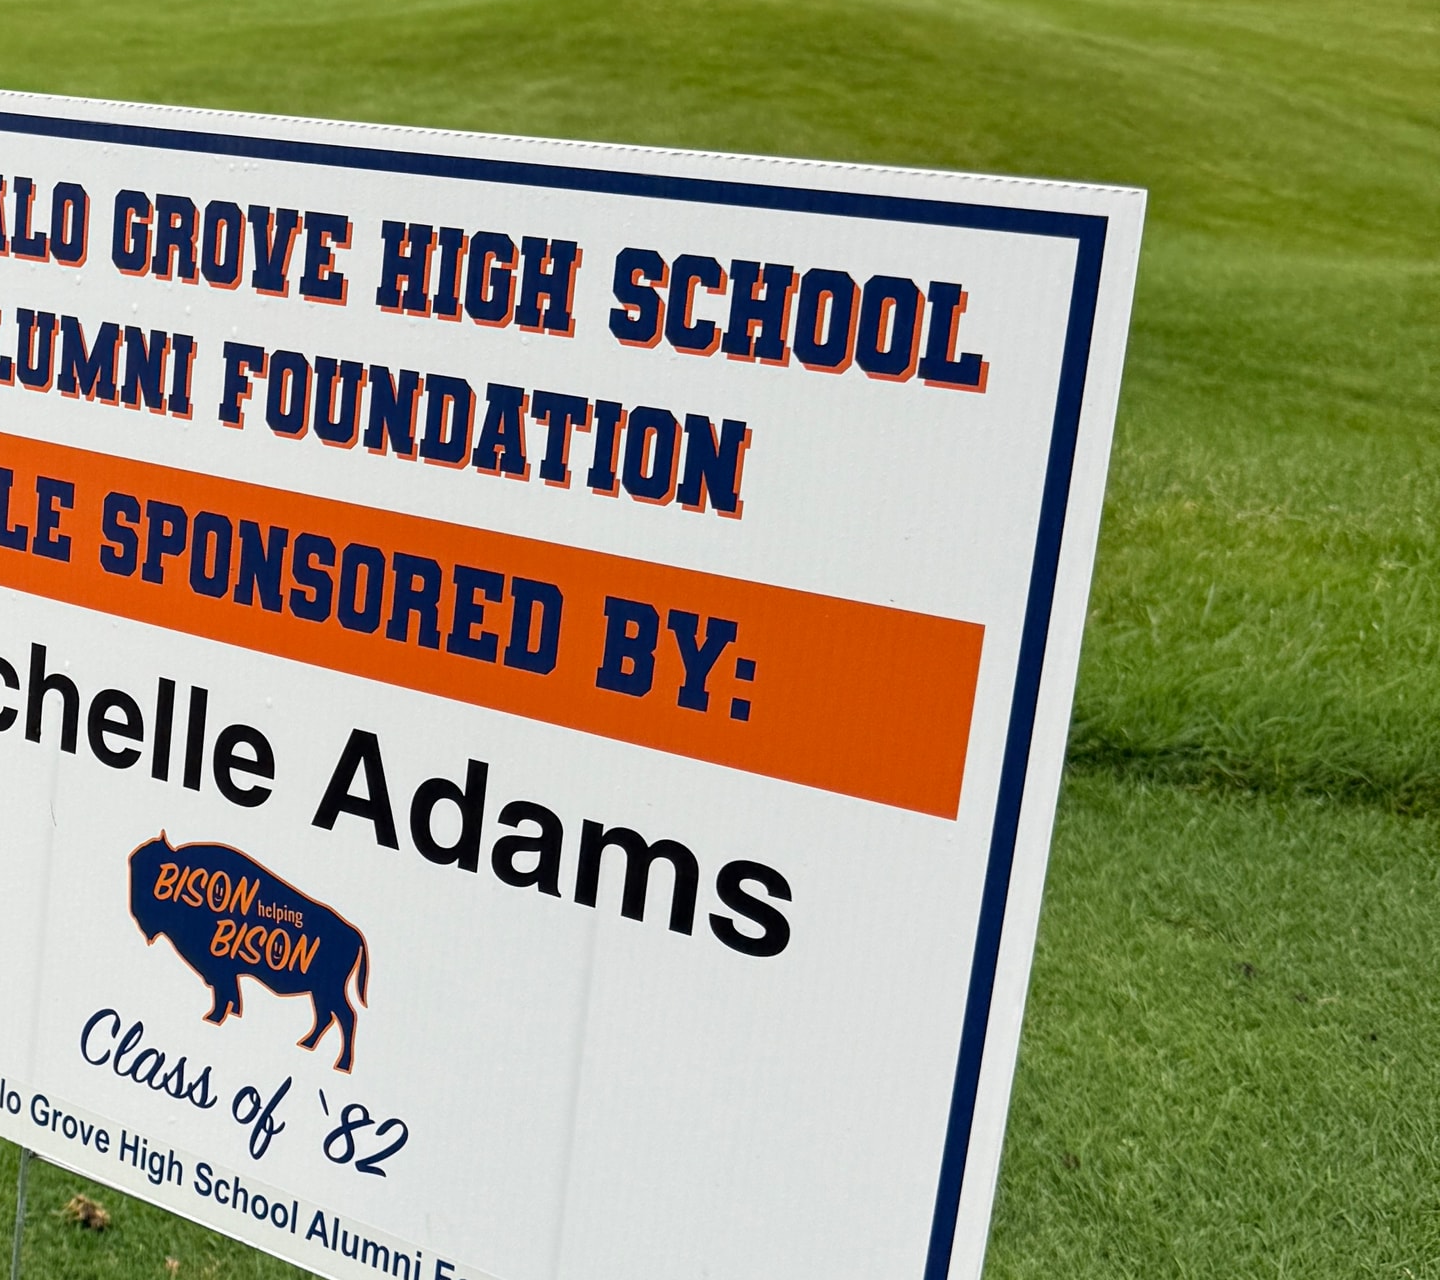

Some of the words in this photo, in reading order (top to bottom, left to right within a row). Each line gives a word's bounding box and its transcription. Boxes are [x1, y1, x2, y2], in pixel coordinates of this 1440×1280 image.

[112, 190, 353, 306] GROVE
[376, 220, 582, 337] HIGH
[609, 248, 989, 393] SCHOOL
[219, 342, 752, 519] FOUNDATION
[100, 492, 563, 675] SPONSORED
[596, 596, 756, 721] BY:
[153, 863, 260, 916] BISON
[257, 900, 303, 928] helping
[312, 729, 792, 957] Adams
[210, 920, 319, 973] BISON
[31, 1094, 109, 1153] Grove
[120, 1130, 182, 1185] High
[194, 1163, 298, 1233] School
[81, 1009, 217, 1108] Class
[232, 1077, 292, 1160] of
